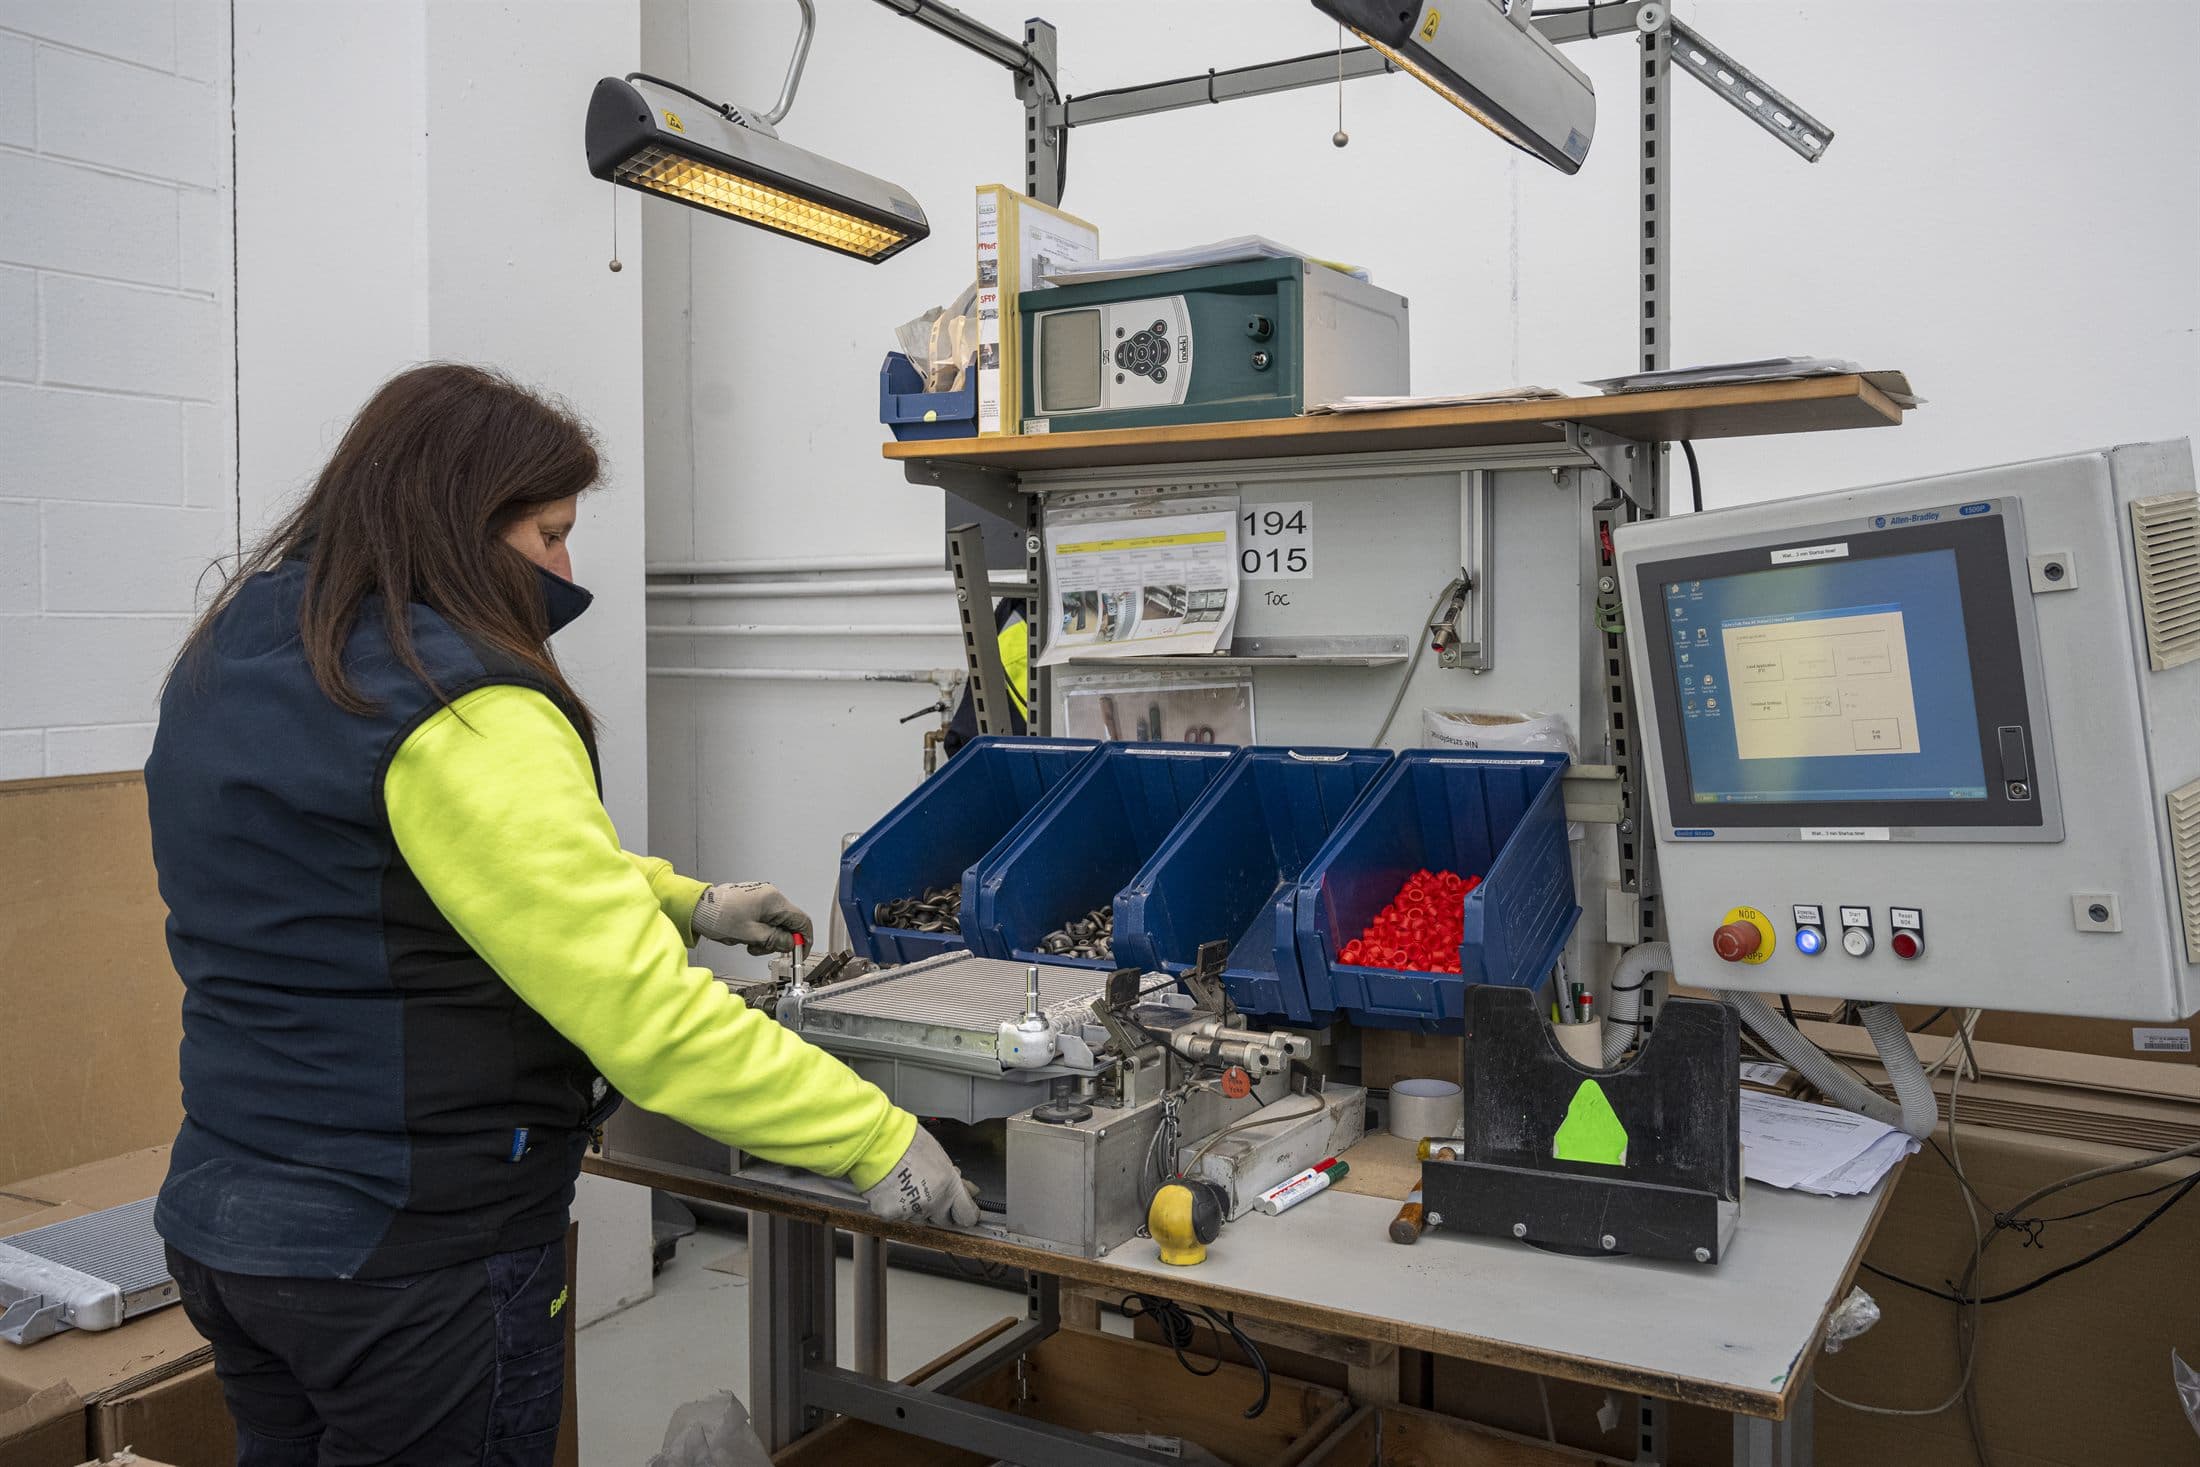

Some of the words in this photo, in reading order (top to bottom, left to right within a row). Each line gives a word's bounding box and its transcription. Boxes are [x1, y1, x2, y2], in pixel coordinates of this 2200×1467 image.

[1243, 510, 1307, 536] 194
[1890, 511, 1940, 526] Allen-Bradley
[1241, 548, 1307, 573] 015
